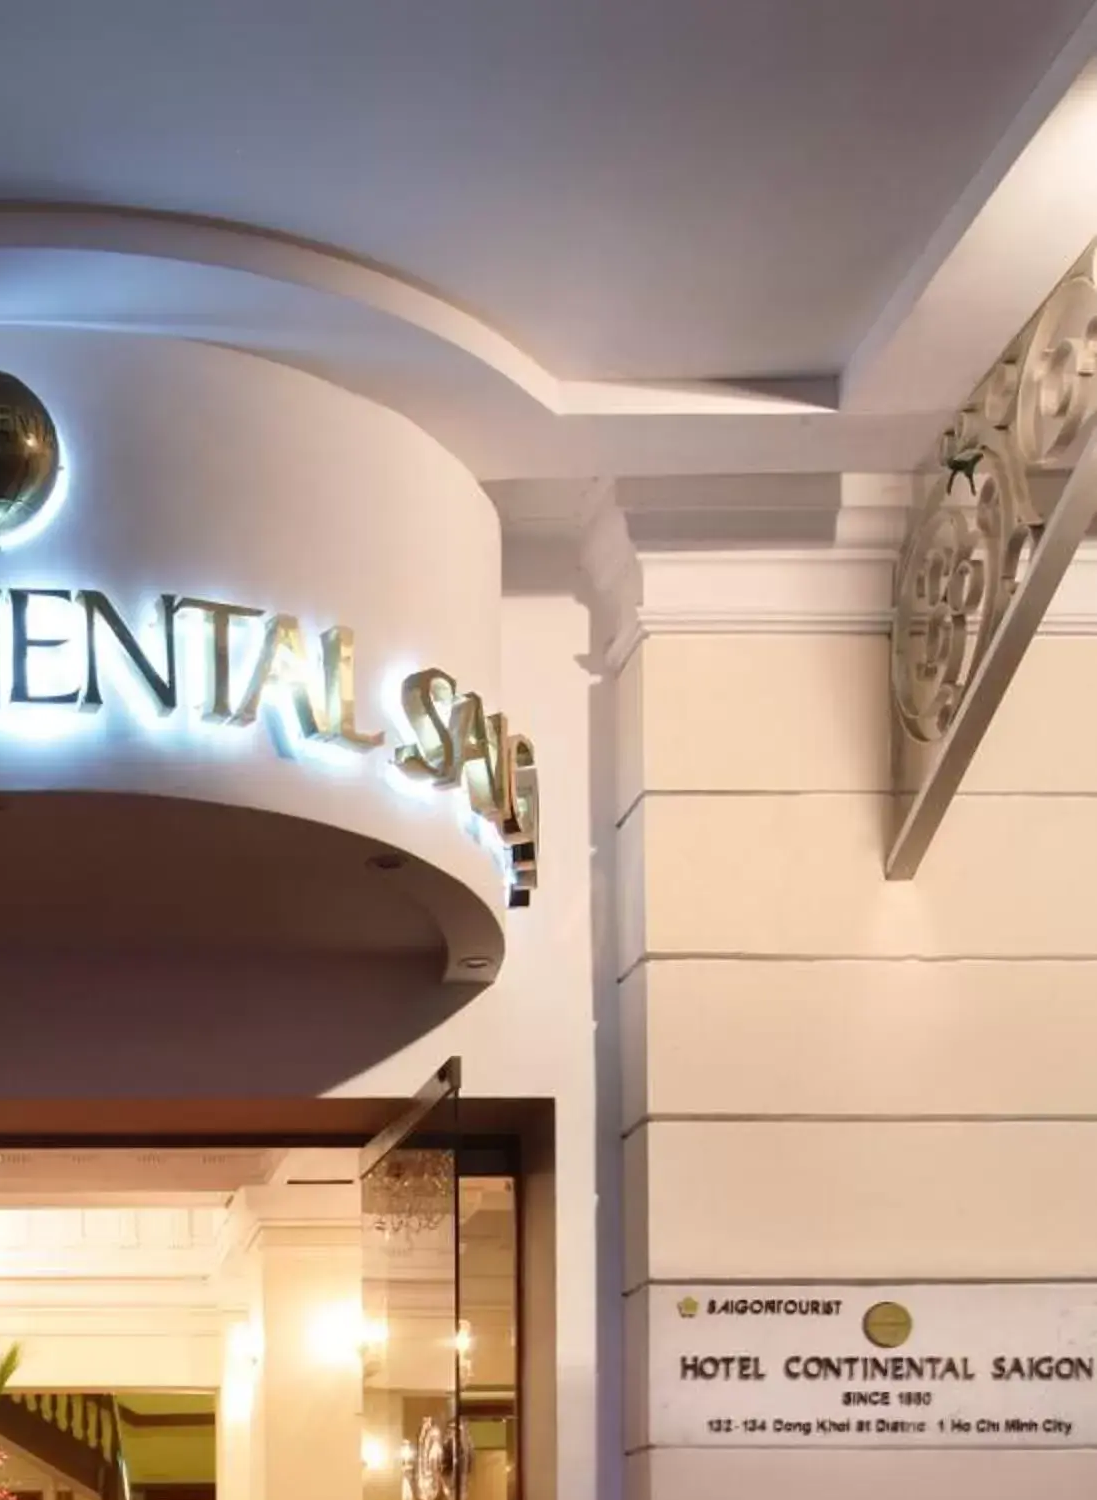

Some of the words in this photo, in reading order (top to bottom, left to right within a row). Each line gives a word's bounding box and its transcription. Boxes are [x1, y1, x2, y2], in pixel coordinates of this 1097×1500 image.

[707, 1299, 842, 1316] SAIGONTOURIST
[680, 1356, 766, 1381] HOTEL
[784, 1356, 975, 1381] CONTINENTAL
[991, 1356, 1094, 1381] SAIGON
[841, 1391, 890, 1406] SINCE
[772, 1418, 812, 1436] Dong
[951, 1418, 971, 1433] Ho
[976, 1418, 1000, 1433] Chi
[1005, 1418, 1038, 1433] Minh
[1042, 1418, 1072, 1436] City
